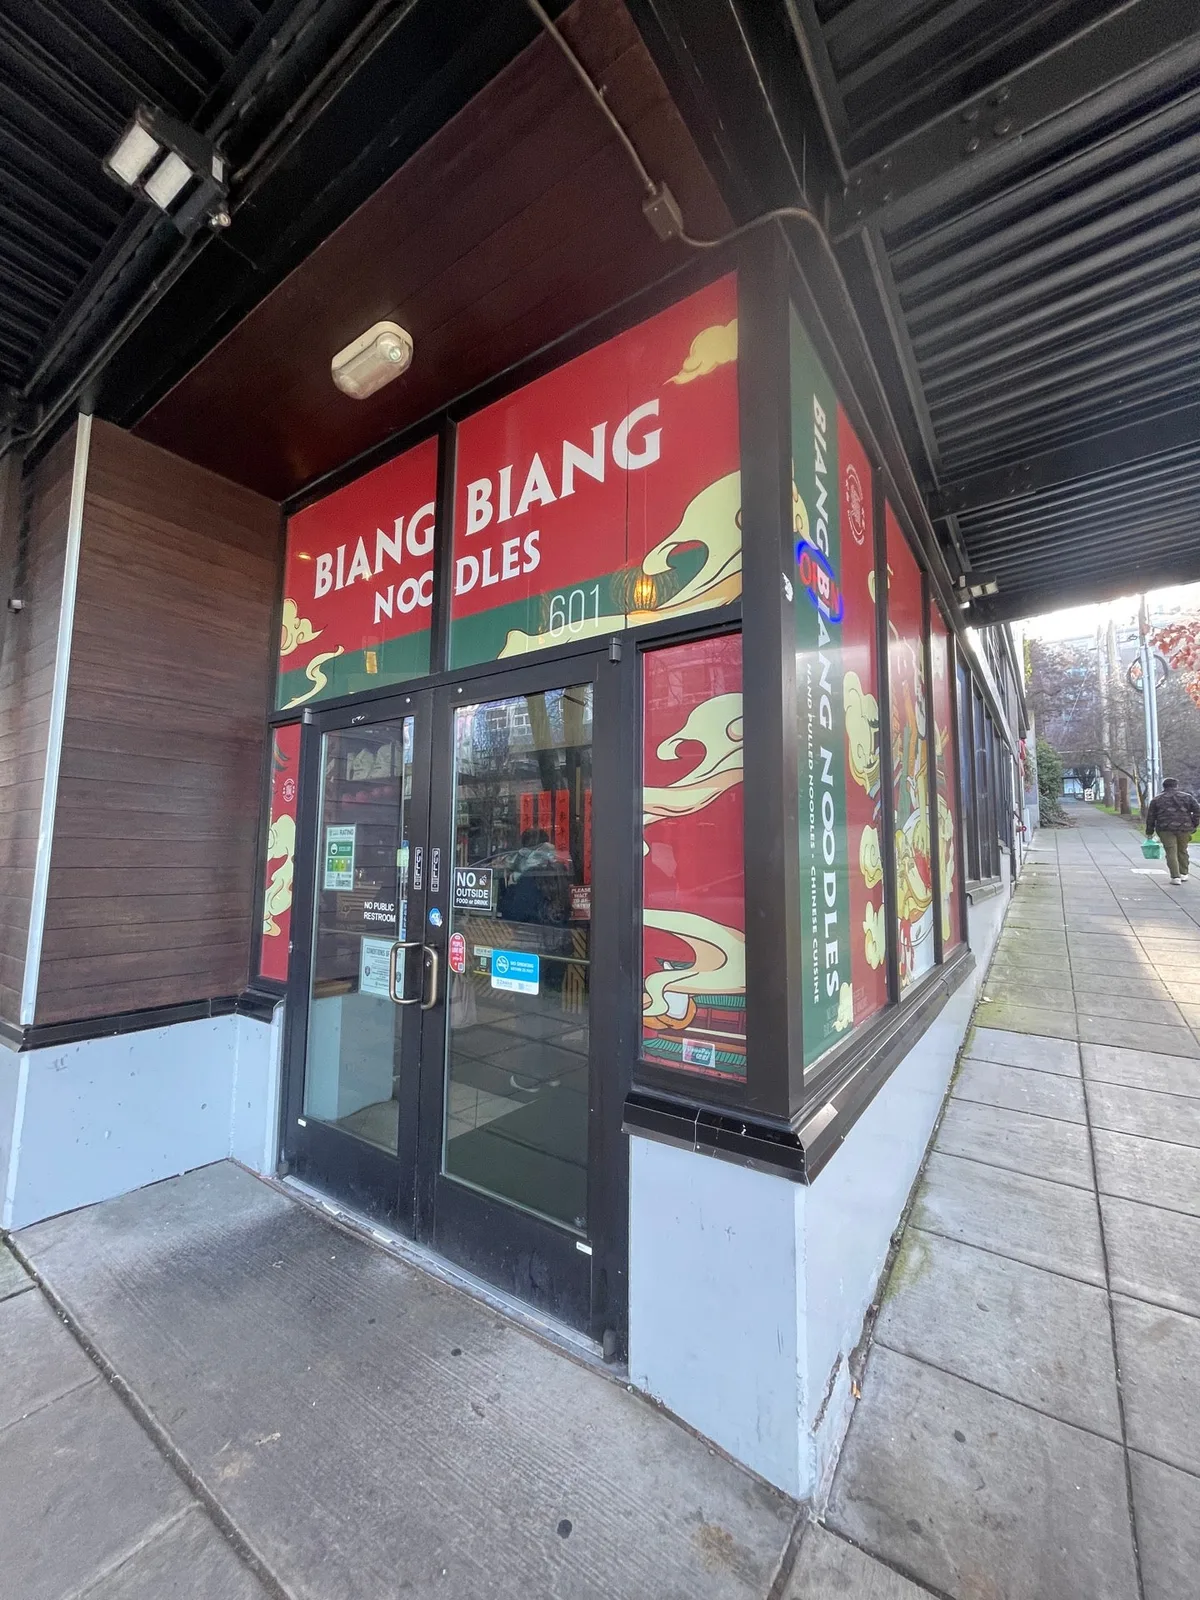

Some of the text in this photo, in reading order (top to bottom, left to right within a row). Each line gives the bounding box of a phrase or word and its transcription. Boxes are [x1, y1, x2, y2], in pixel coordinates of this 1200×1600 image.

[314, 398, 663, 600] BIANG BIANG
[813, 393, 829, 558] BIANG
[549, 584, 600, 638] 601
[817, 565, 832, 731] BIANG
[808, 775, 816, 849] NOODLES
[456, 888, 489, 898] OUTSIDE
[457, 872, 476, 887] NO
[810, 866, 818, 933] CHINESE
[820, 745, 840, 997] NOODLES
[363, 901, 395, 912] NO PUBLIC
[363, 911, 396, 923] RESTROOM
[812, 938, 820, 1004] CUISINE
